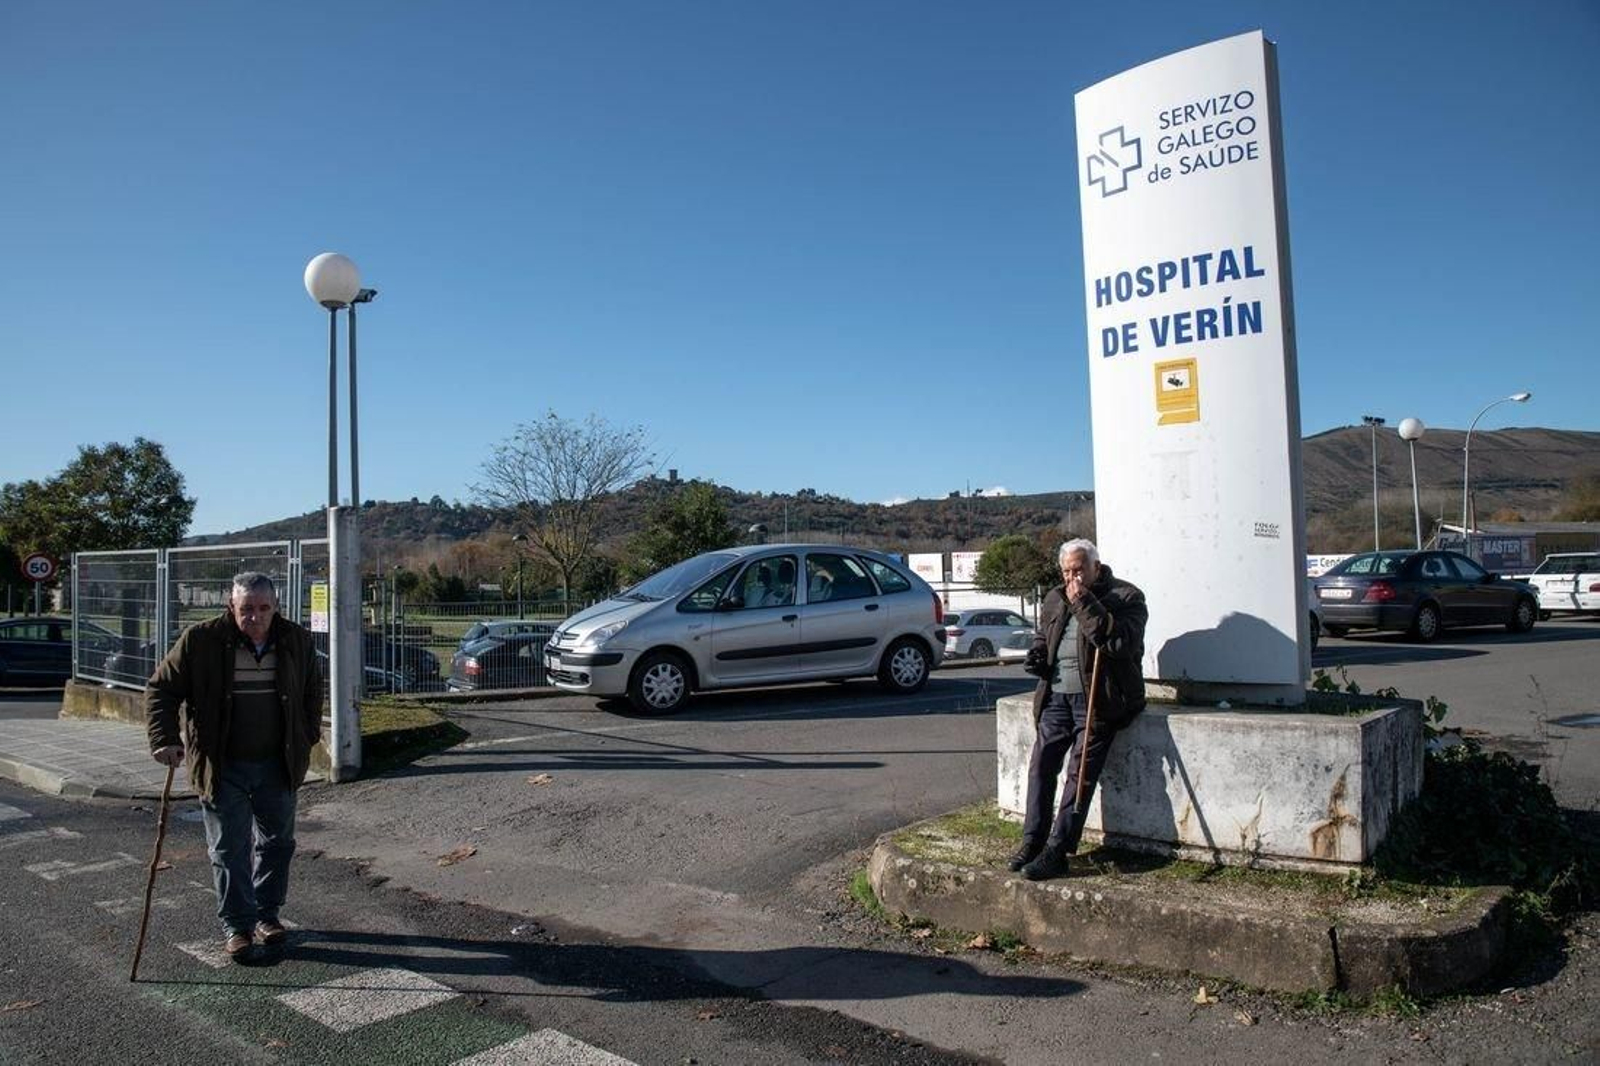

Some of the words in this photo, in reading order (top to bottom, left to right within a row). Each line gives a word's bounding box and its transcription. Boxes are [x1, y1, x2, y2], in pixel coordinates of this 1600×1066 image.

[1159, 91, 1254, 130] SERVIZO
[1157, 116, 1256, 155] GALEGO
[1147, 163, 1172, 184] de
[1179, 141, 1259, 175] SAÚDE
[1095, 246, 1265, 308] HOSPITAL
[1102, 322, 1139, 358] DE
[1149, 296, 1263, 348] VERÍN
[1482, 539, 1521, 554] MASTER
[30, 562, 49, 574] 50
